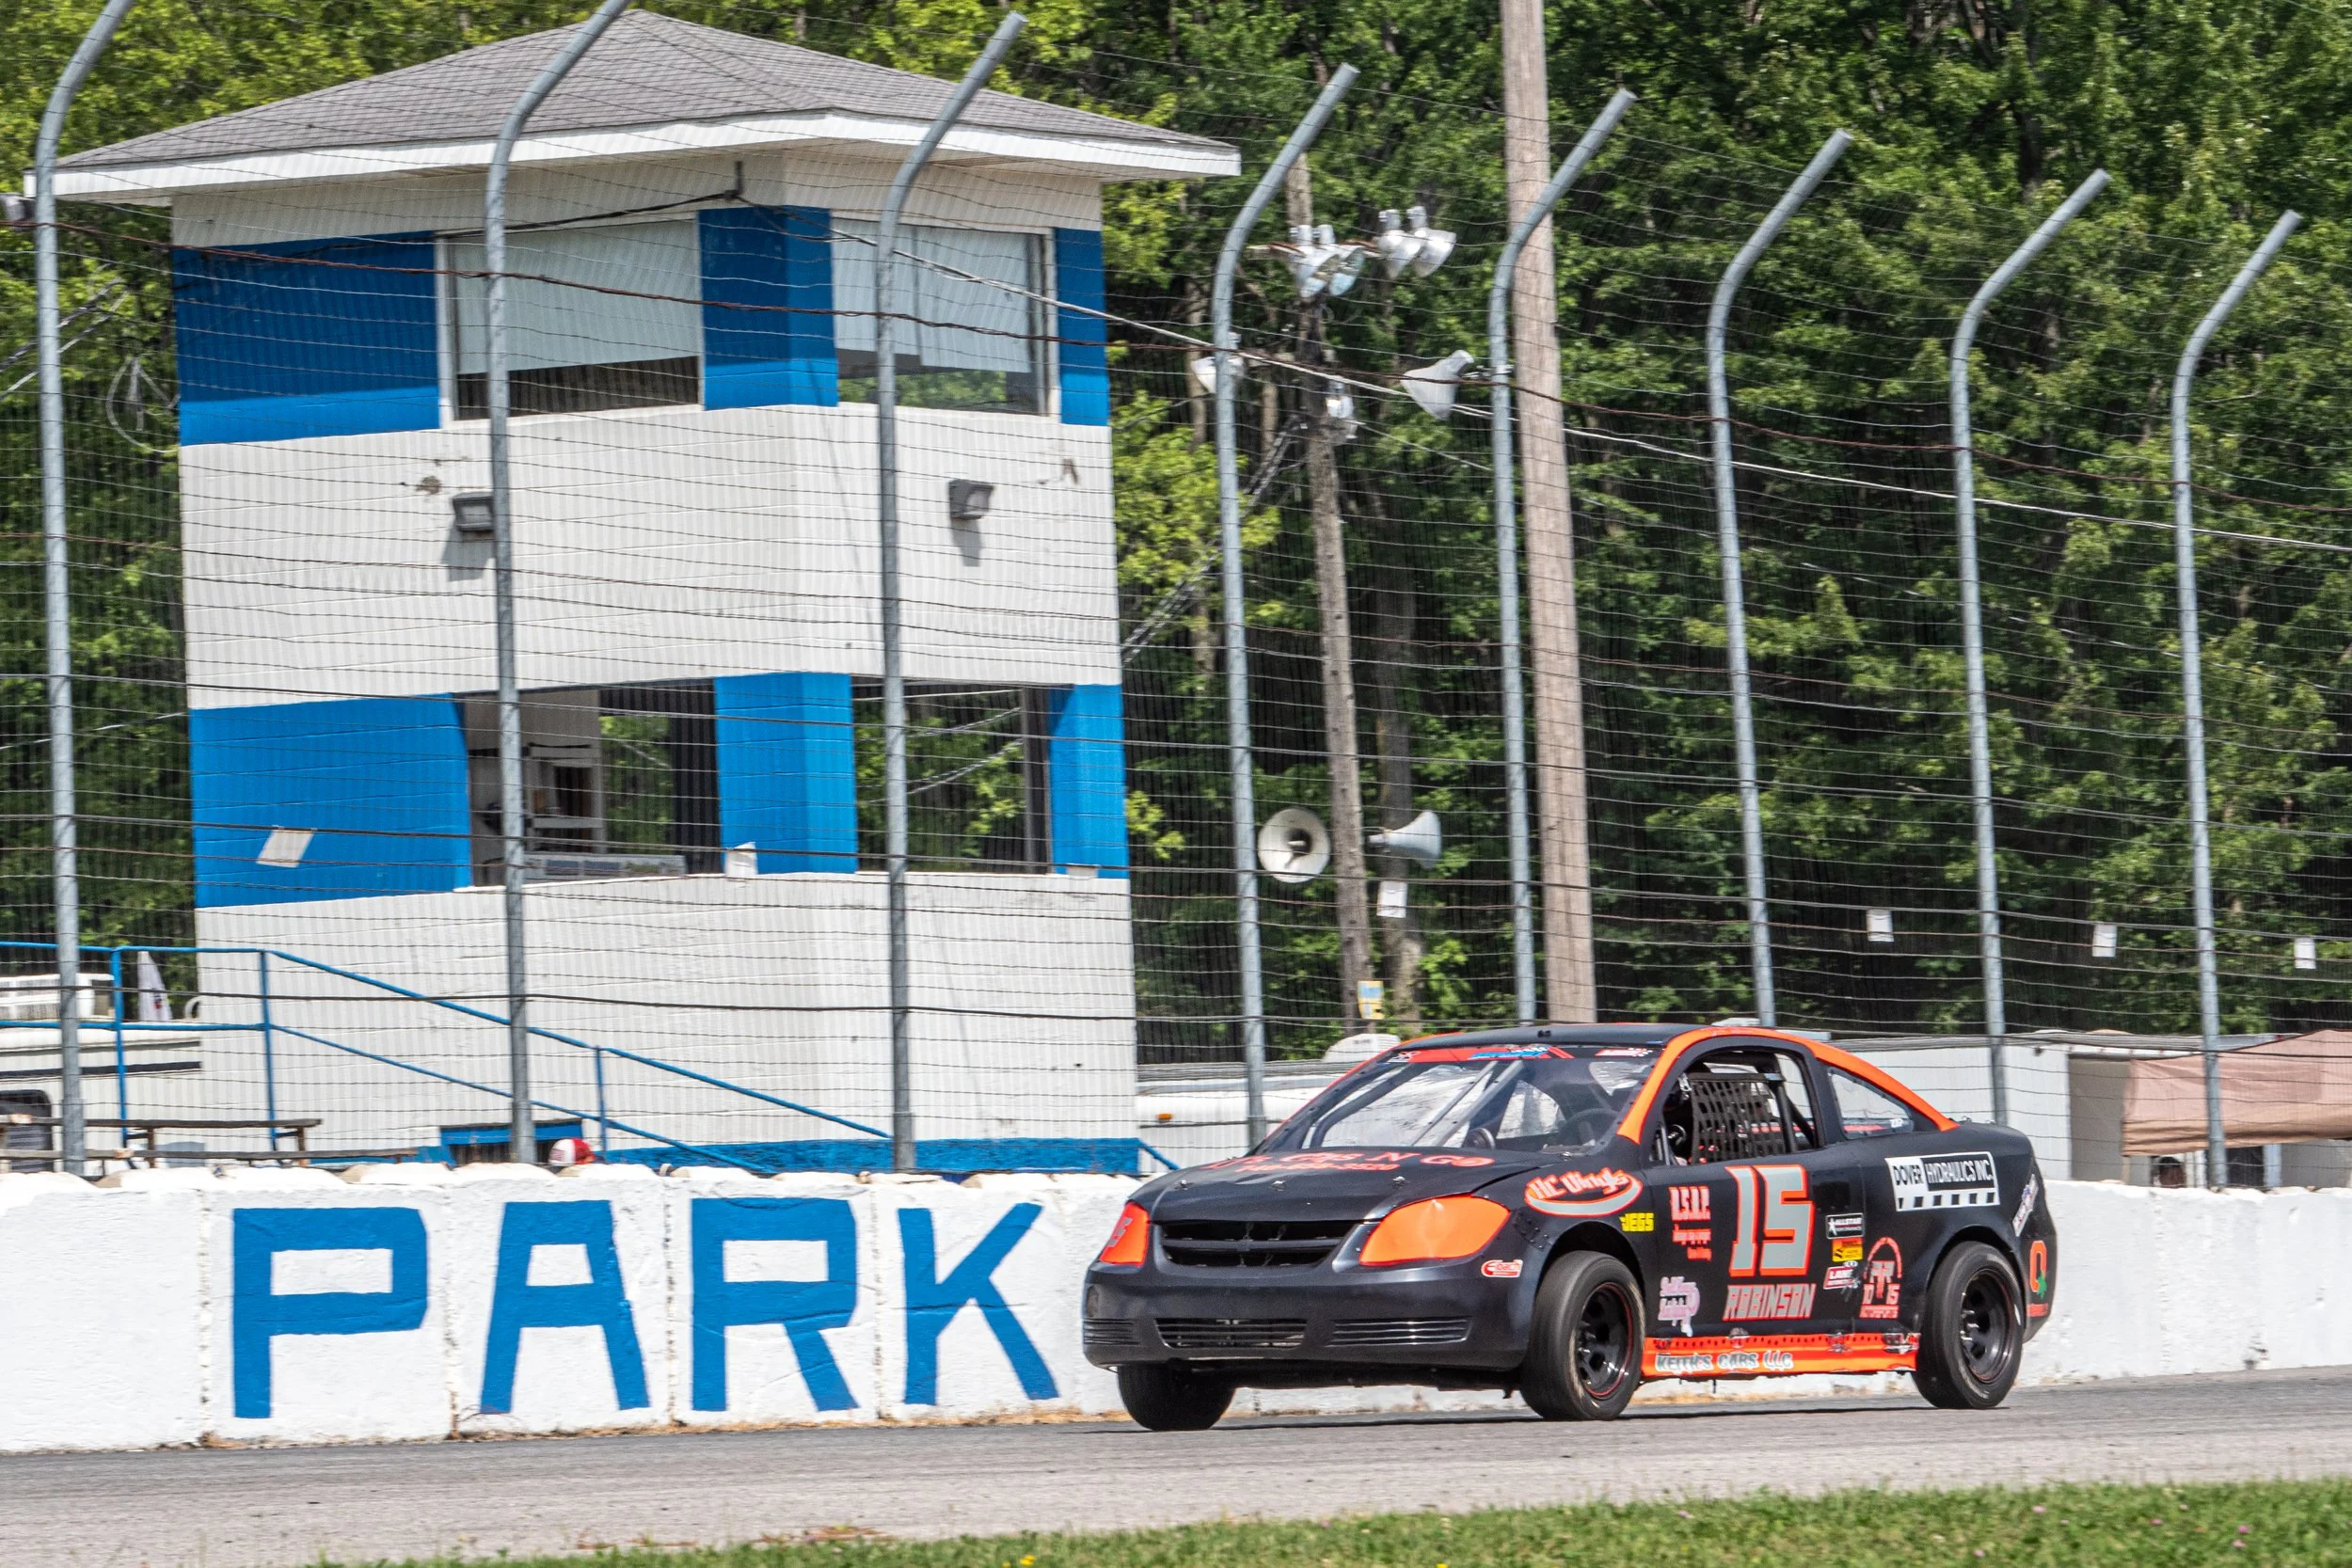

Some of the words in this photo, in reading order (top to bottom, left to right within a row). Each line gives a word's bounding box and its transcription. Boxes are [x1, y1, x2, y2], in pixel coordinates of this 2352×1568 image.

[1891, 1164, 1925, 1186] DOVER
[1924, 1160, 1976, 1184] HYDRAULICS
[1976, 1159, 1994, 1182] INC.
[1619, 1212, 1655, 1232] JEGS
[1724, 1164, 1816, 1277] 15
[232, 1197, 1061, 1419] PARK
[1722, 1283, 1818, 1322] ROBINSON
[1717, 1352, 1759, 1370] CARS
[1762, 1349, 1795, 1371] LLC
